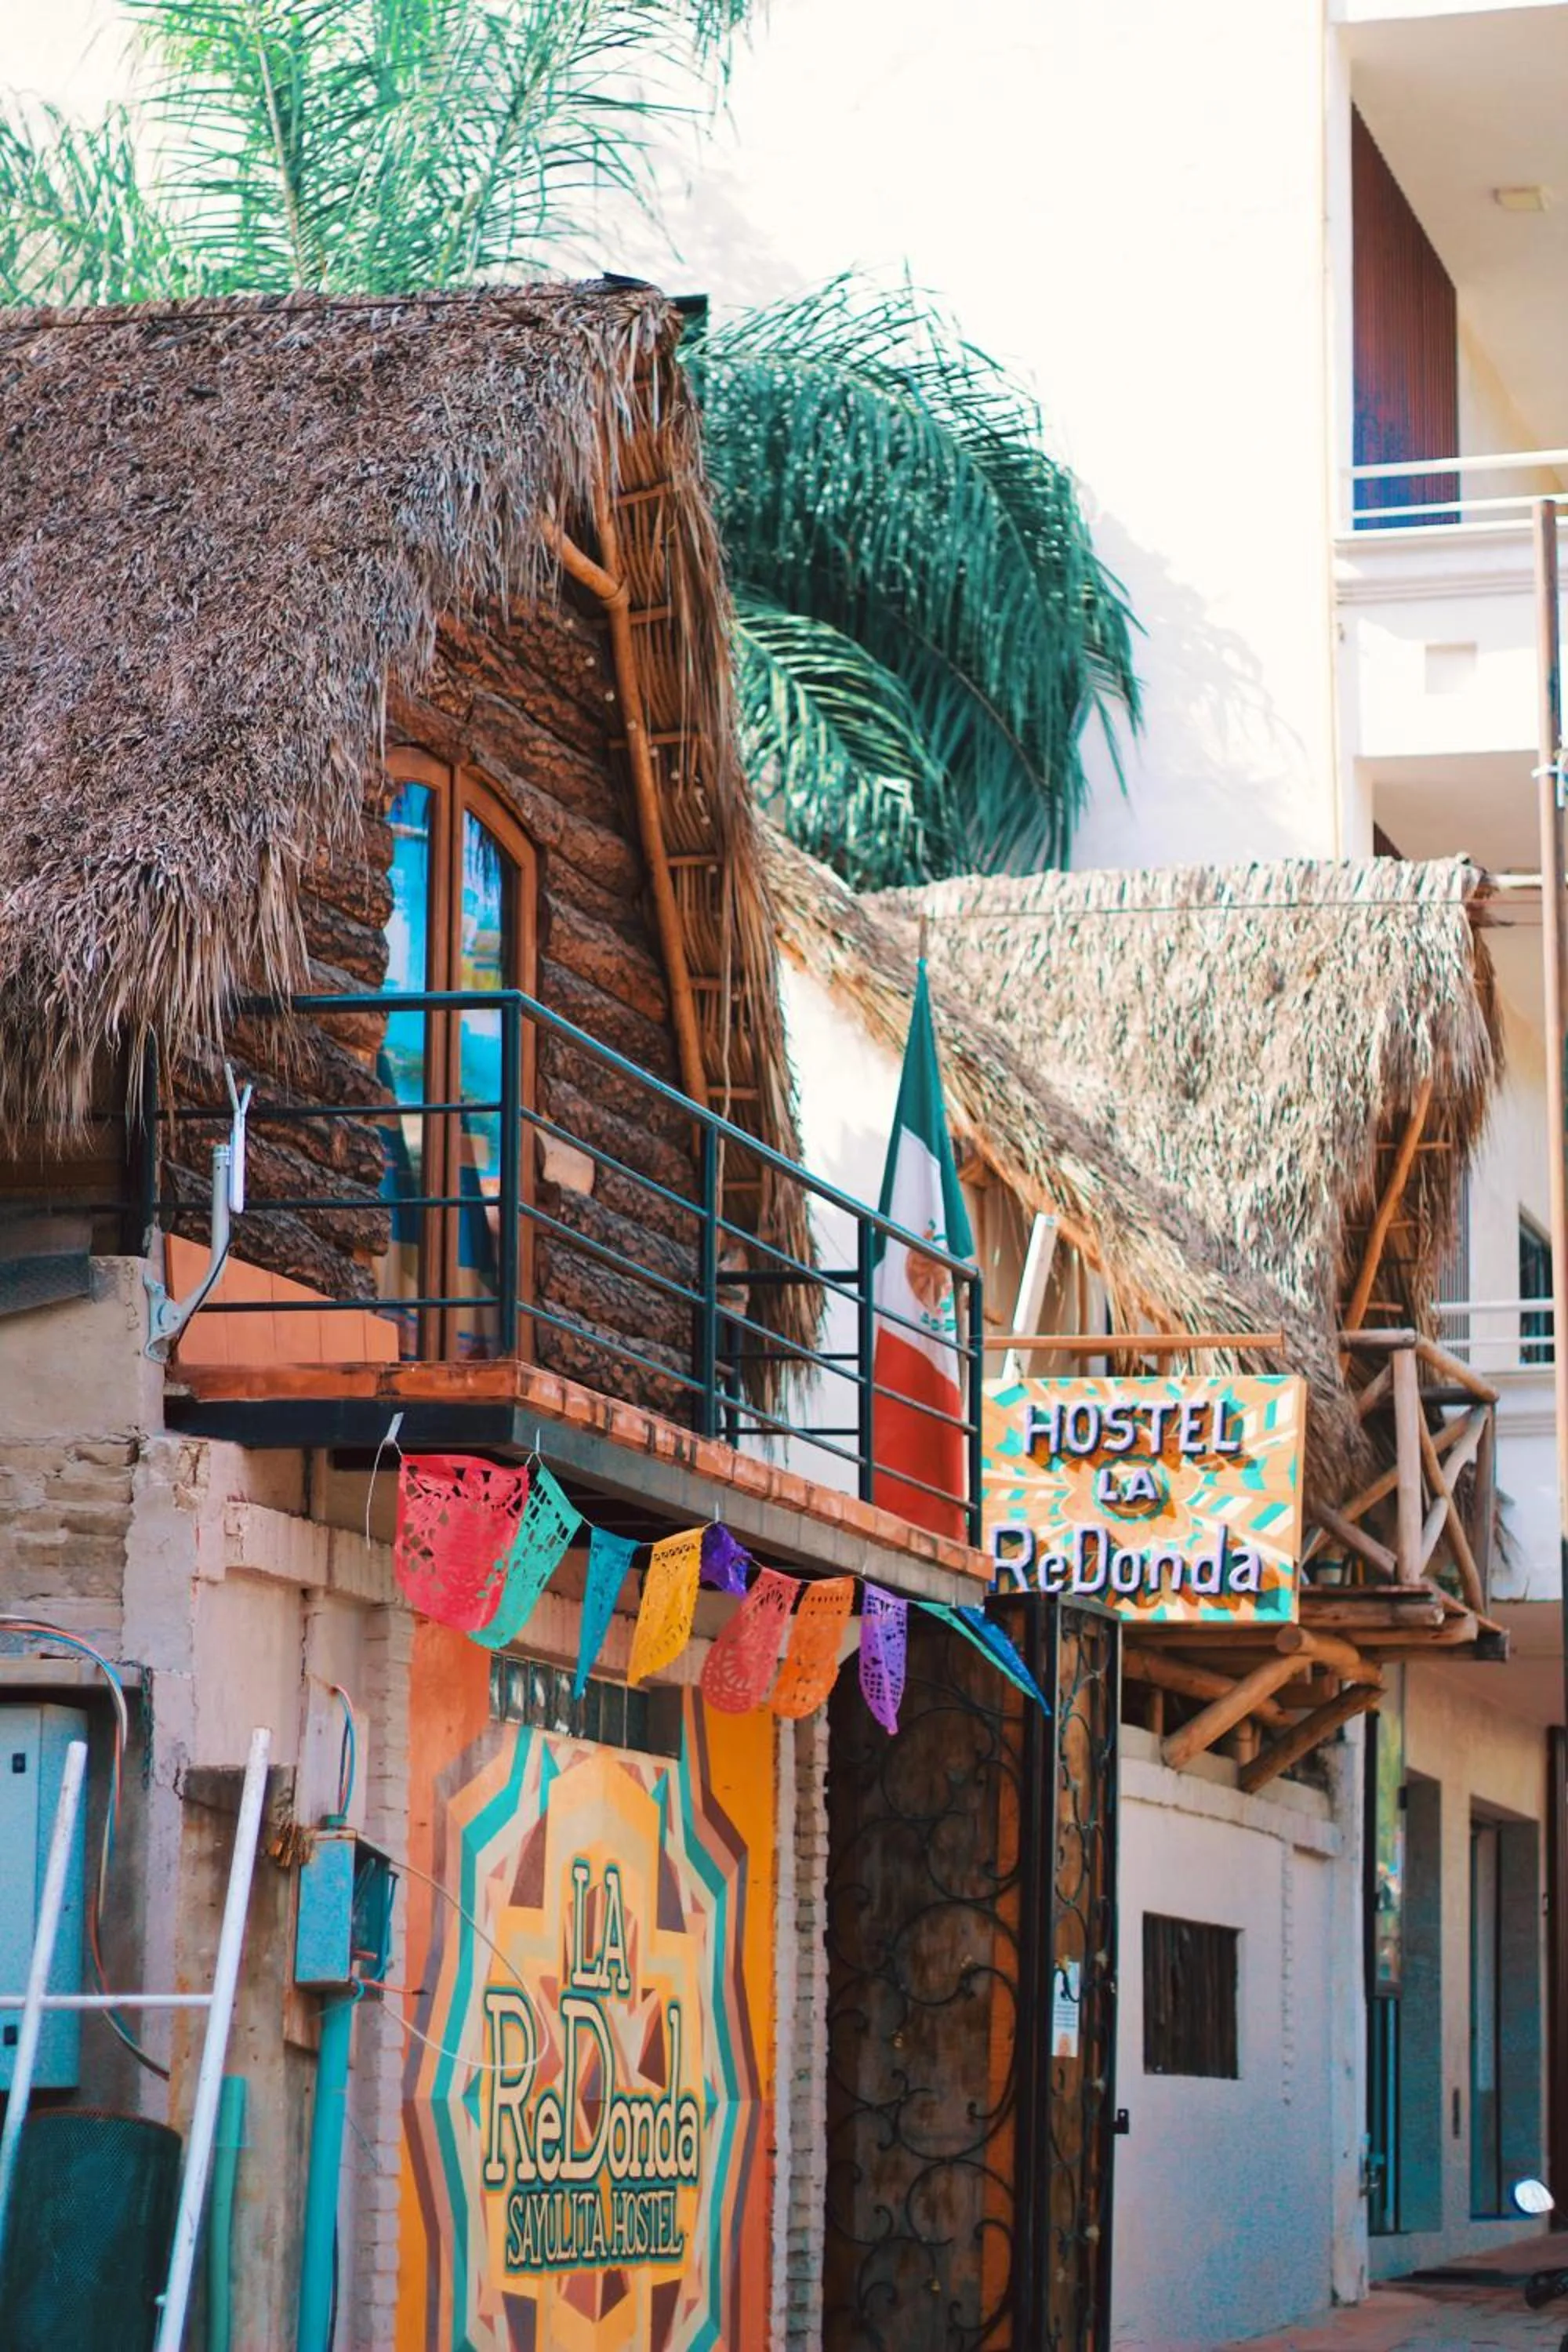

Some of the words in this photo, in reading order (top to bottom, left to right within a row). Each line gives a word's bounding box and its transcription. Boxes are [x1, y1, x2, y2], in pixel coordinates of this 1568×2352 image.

[1024, 1399, 1242, 1456] HOSTEL
[1098, 1466, 1161, 1504] LA
[990, 1523, 1264, 1595] ReDonda
[570, 1860, 631, 1993] LA
[482, 1990, 702, 2184] ReDonda
[506, 2193, 606, 2267] SAYULITA
[609, 2189, 684, 2259] HOSTEL
